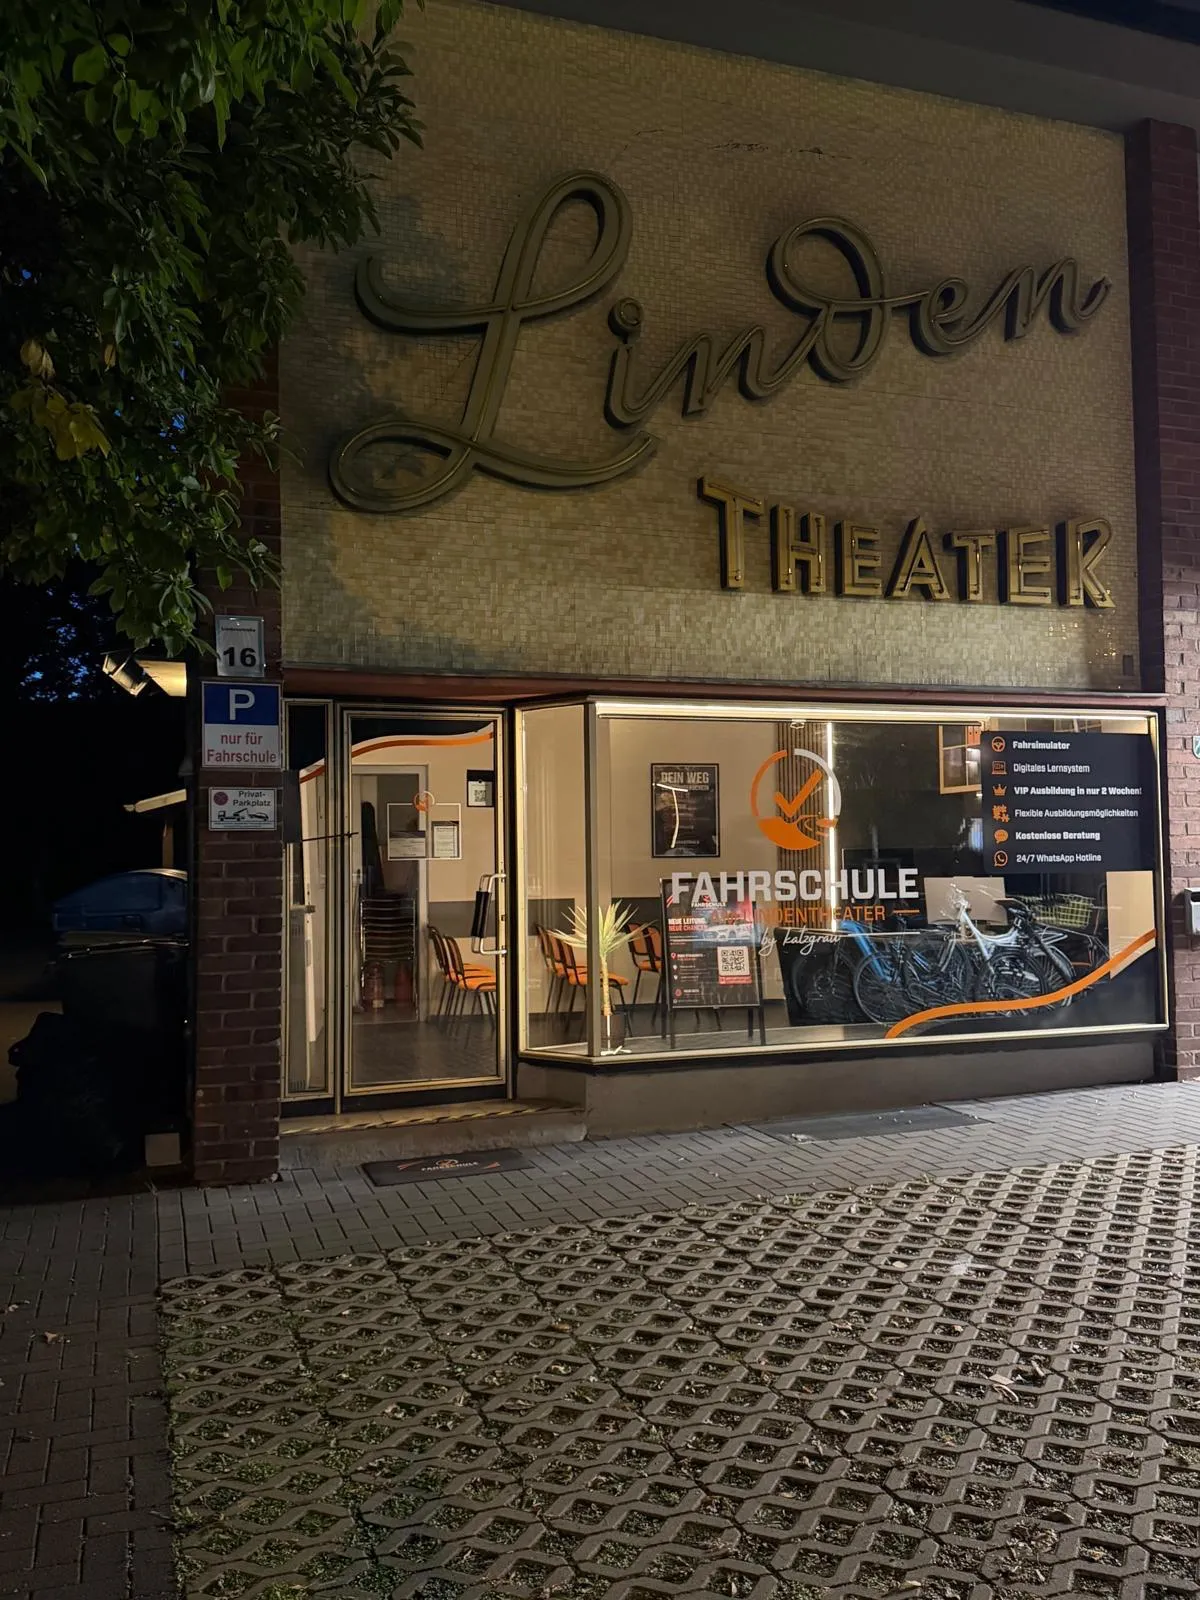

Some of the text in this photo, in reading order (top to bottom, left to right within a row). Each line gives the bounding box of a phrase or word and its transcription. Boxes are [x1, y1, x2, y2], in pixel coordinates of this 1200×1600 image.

[328, 170, 1111, 513] Linden
[696, 475, 1116, 610] THEATER
[223, 646, 257, 667] 16
[229, 688, 256, 721] P
[220, 732, 263, 745] nur für
[1012, 741, 1071, 750] Fahrsimulator
[207, 749, 277, 763] Fahrschule
[1013, 763, 1090, 774] Digitales Lernsystem
[660, 771, 709, 784] DEIN WEG
[238, 790, 266, 798] Privat-
[1014, 787, 1029, 795] VIP
[1030, 787, 1076, 796] Ausbildung
[1077, 787, 1085, 795] in
[1101, 787, 1107, 795] 2
[1108, 787, 1142, 795] Wochen!
[232, 799, 271, 807] Parkplatz
[1015, 809, 1139, 819] Flexible Ausbildungsmöglichkeiten
[1015, 831, 1100, 841] Kostenlose Beratung
[1016, 853, 1102, 863] 24/7 WhatsApp Hotline
[671, 868, 920, 903] FAHRSCHULE
[758, 927, 778, 957] by
